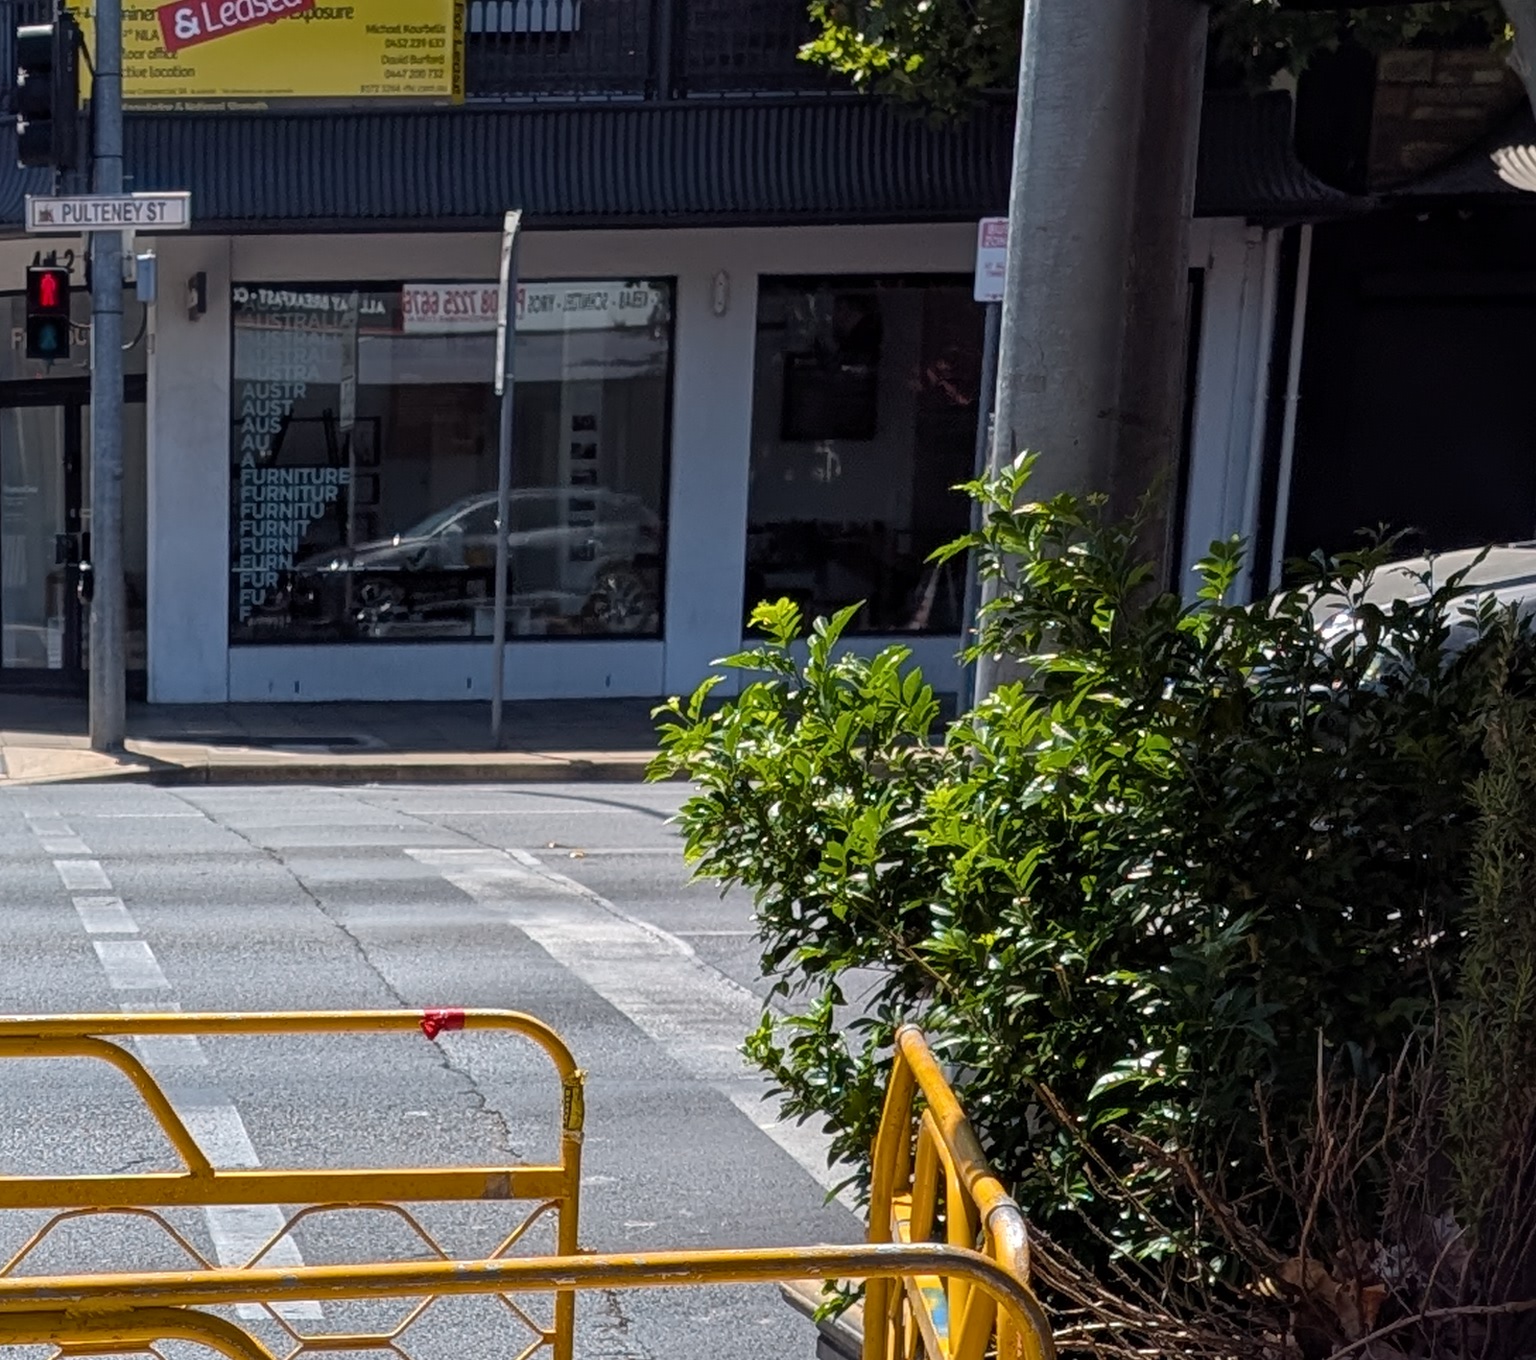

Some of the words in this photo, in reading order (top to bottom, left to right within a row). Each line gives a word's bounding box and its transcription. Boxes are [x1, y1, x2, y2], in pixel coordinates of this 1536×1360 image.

[175, 8, 201, 39] &
[62, 203, 143, 222] PULTENEY
[146, 202, 167, 221] ST
[242, 383, 307, 399] AUSTR
[241, 400, 294, 416] AUST
[241, 417, 282, 433] AUS
[241, 434, 270, 451] AU
[241, 452, 256, 468] A
[241, 468, 350, 485] FURNITURE
[241, 485, 338, 502] FURNITUR
[240, 503, 325, 519] FURNITU
[240, 520, 311, 537] FURNIT
[240, 537, 298, 554] FURNI
[240, 554, 293, 571] FURN
[240, 572, 278, 588] FUR
[240, 589, 266, 605] FU
[239, 606, 253, 622] F
